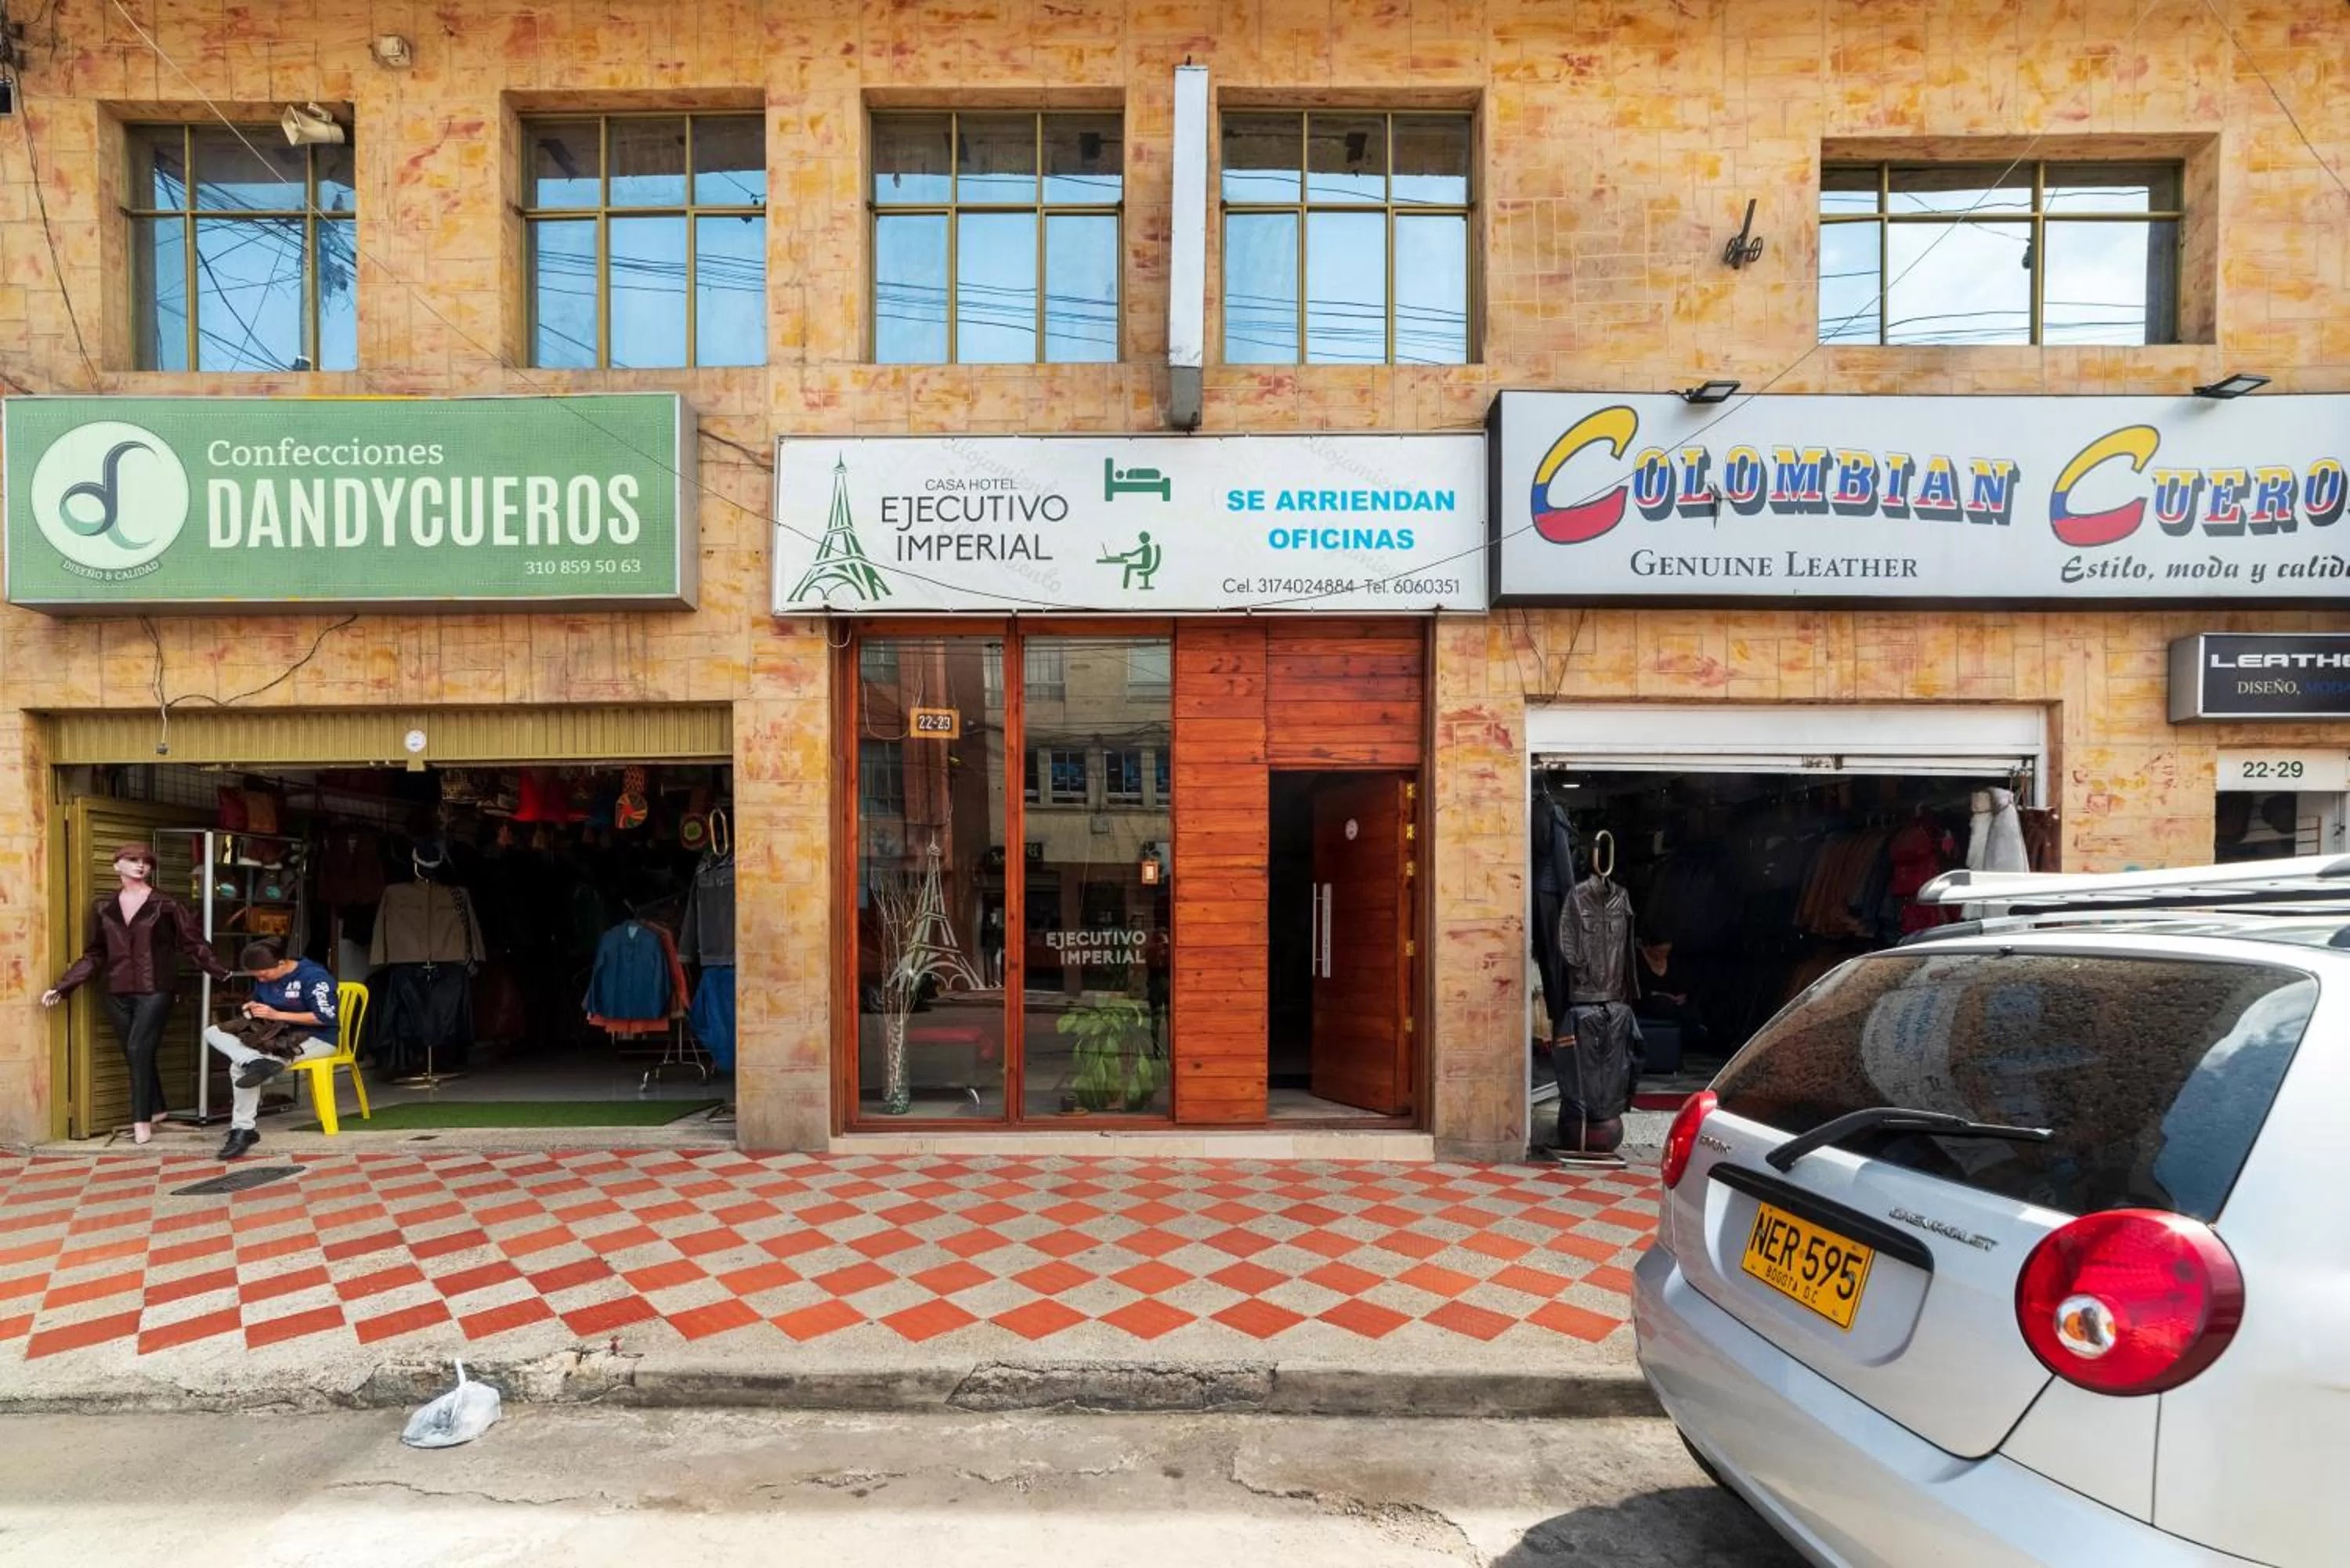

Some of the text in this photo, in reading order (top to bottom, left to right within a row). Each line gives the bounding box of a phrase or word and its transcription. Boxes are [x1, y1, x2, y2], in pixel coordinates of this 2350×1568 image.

[208, 437, 444, 467] Confecciones
[925, 478, 1018, 491] CASA HOTEL
[1531, 405, 2350, 547] COLOMBIAN CUERO
[208, 474, 640, 548] DANDYCUEROS
[1227, 490, 1455, 511] SE ARRIENDAN
[881, 494, 1069, 531] EJECUTIVO
[897, 534, 1054, 562] IMPERIAL
[1268, 529, 1415, 550] OFICINAS
[526, 559, 641, 575] 310 859 50 63
[1630, 549, 1919, 578] GENUINE LEATHER
[2060, 555, 2155, 583] Estilo,
[2165, 555, 2239, 579] moda
[2251, 562, 2267, 583] y
[1223, 578, 1460, 595] Cel. 3174024884 Tel. 6060351
[2237, 678, 2301, 695] DISEÑO,
[919, 714, 951, 730] 22-23
[2243, 761, 2304, 779] 22-29
[1046, 930, 1148, 950] EJECUTIVO
[1060, 949, 1147, 966] IMPERIAL
[1750, 1212, 1864, 1301] NER 595
